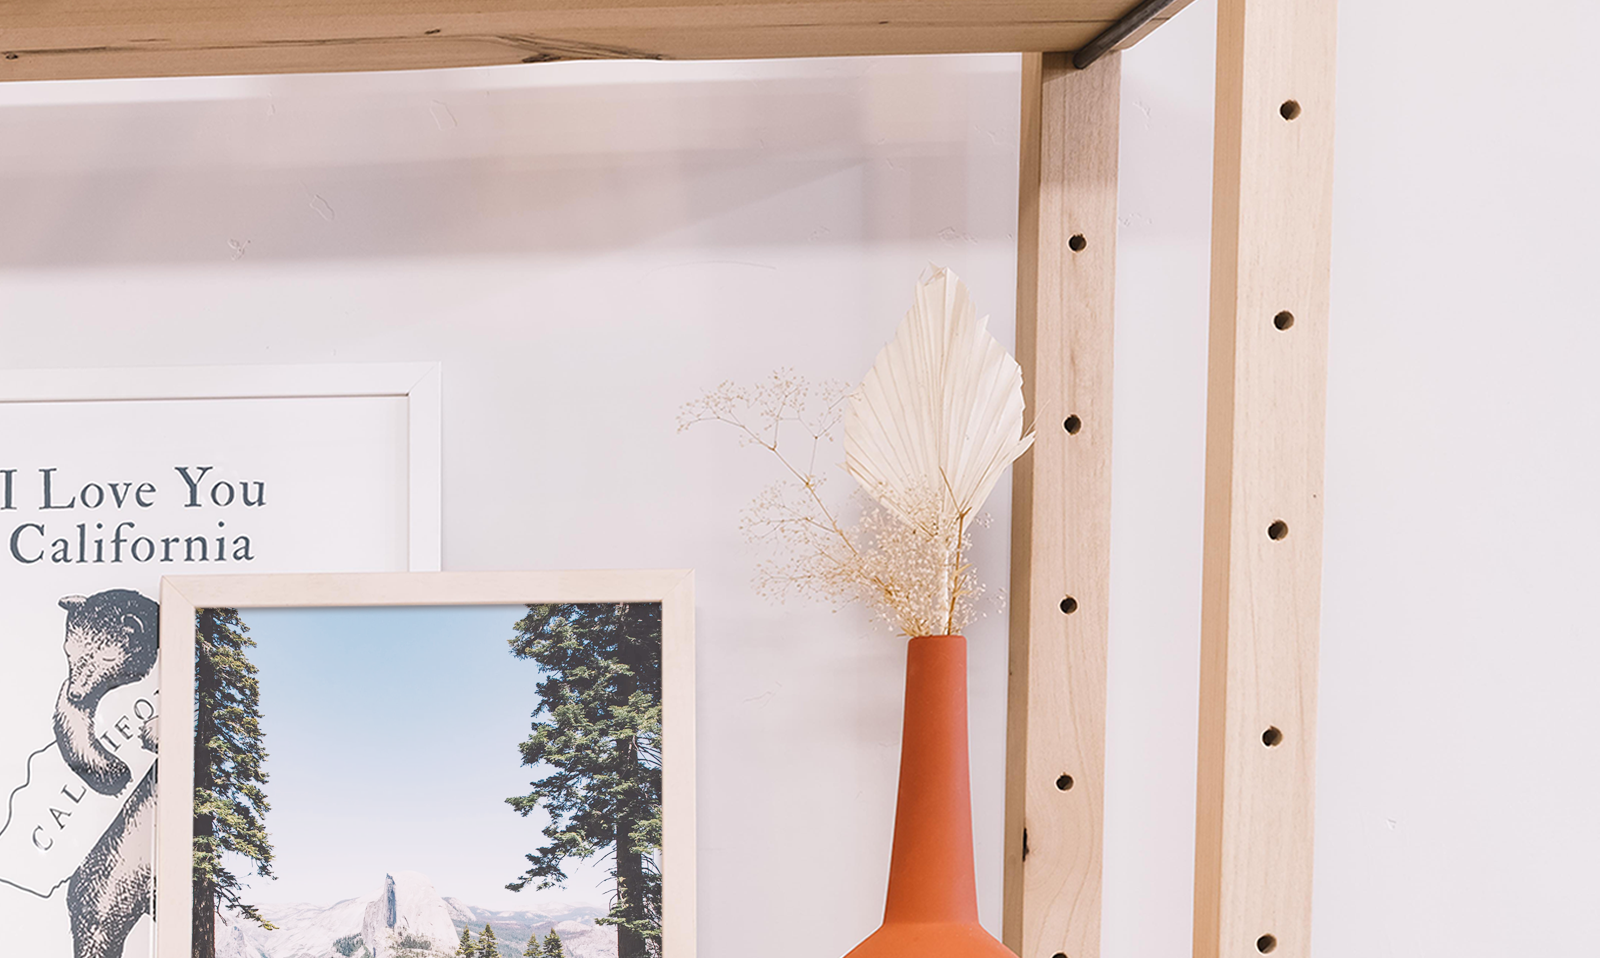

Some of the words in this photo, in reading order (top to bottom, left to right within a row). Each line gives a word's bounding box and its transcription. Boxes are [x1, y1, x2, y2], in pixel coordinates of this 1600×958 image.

[0, 468, 18, 510] I
[38, 467, 157, 510] Love
[174, 466, 267, 508] You
[9, 521, 255, 564] California
[32, 689, 158, 852] CALIFO
